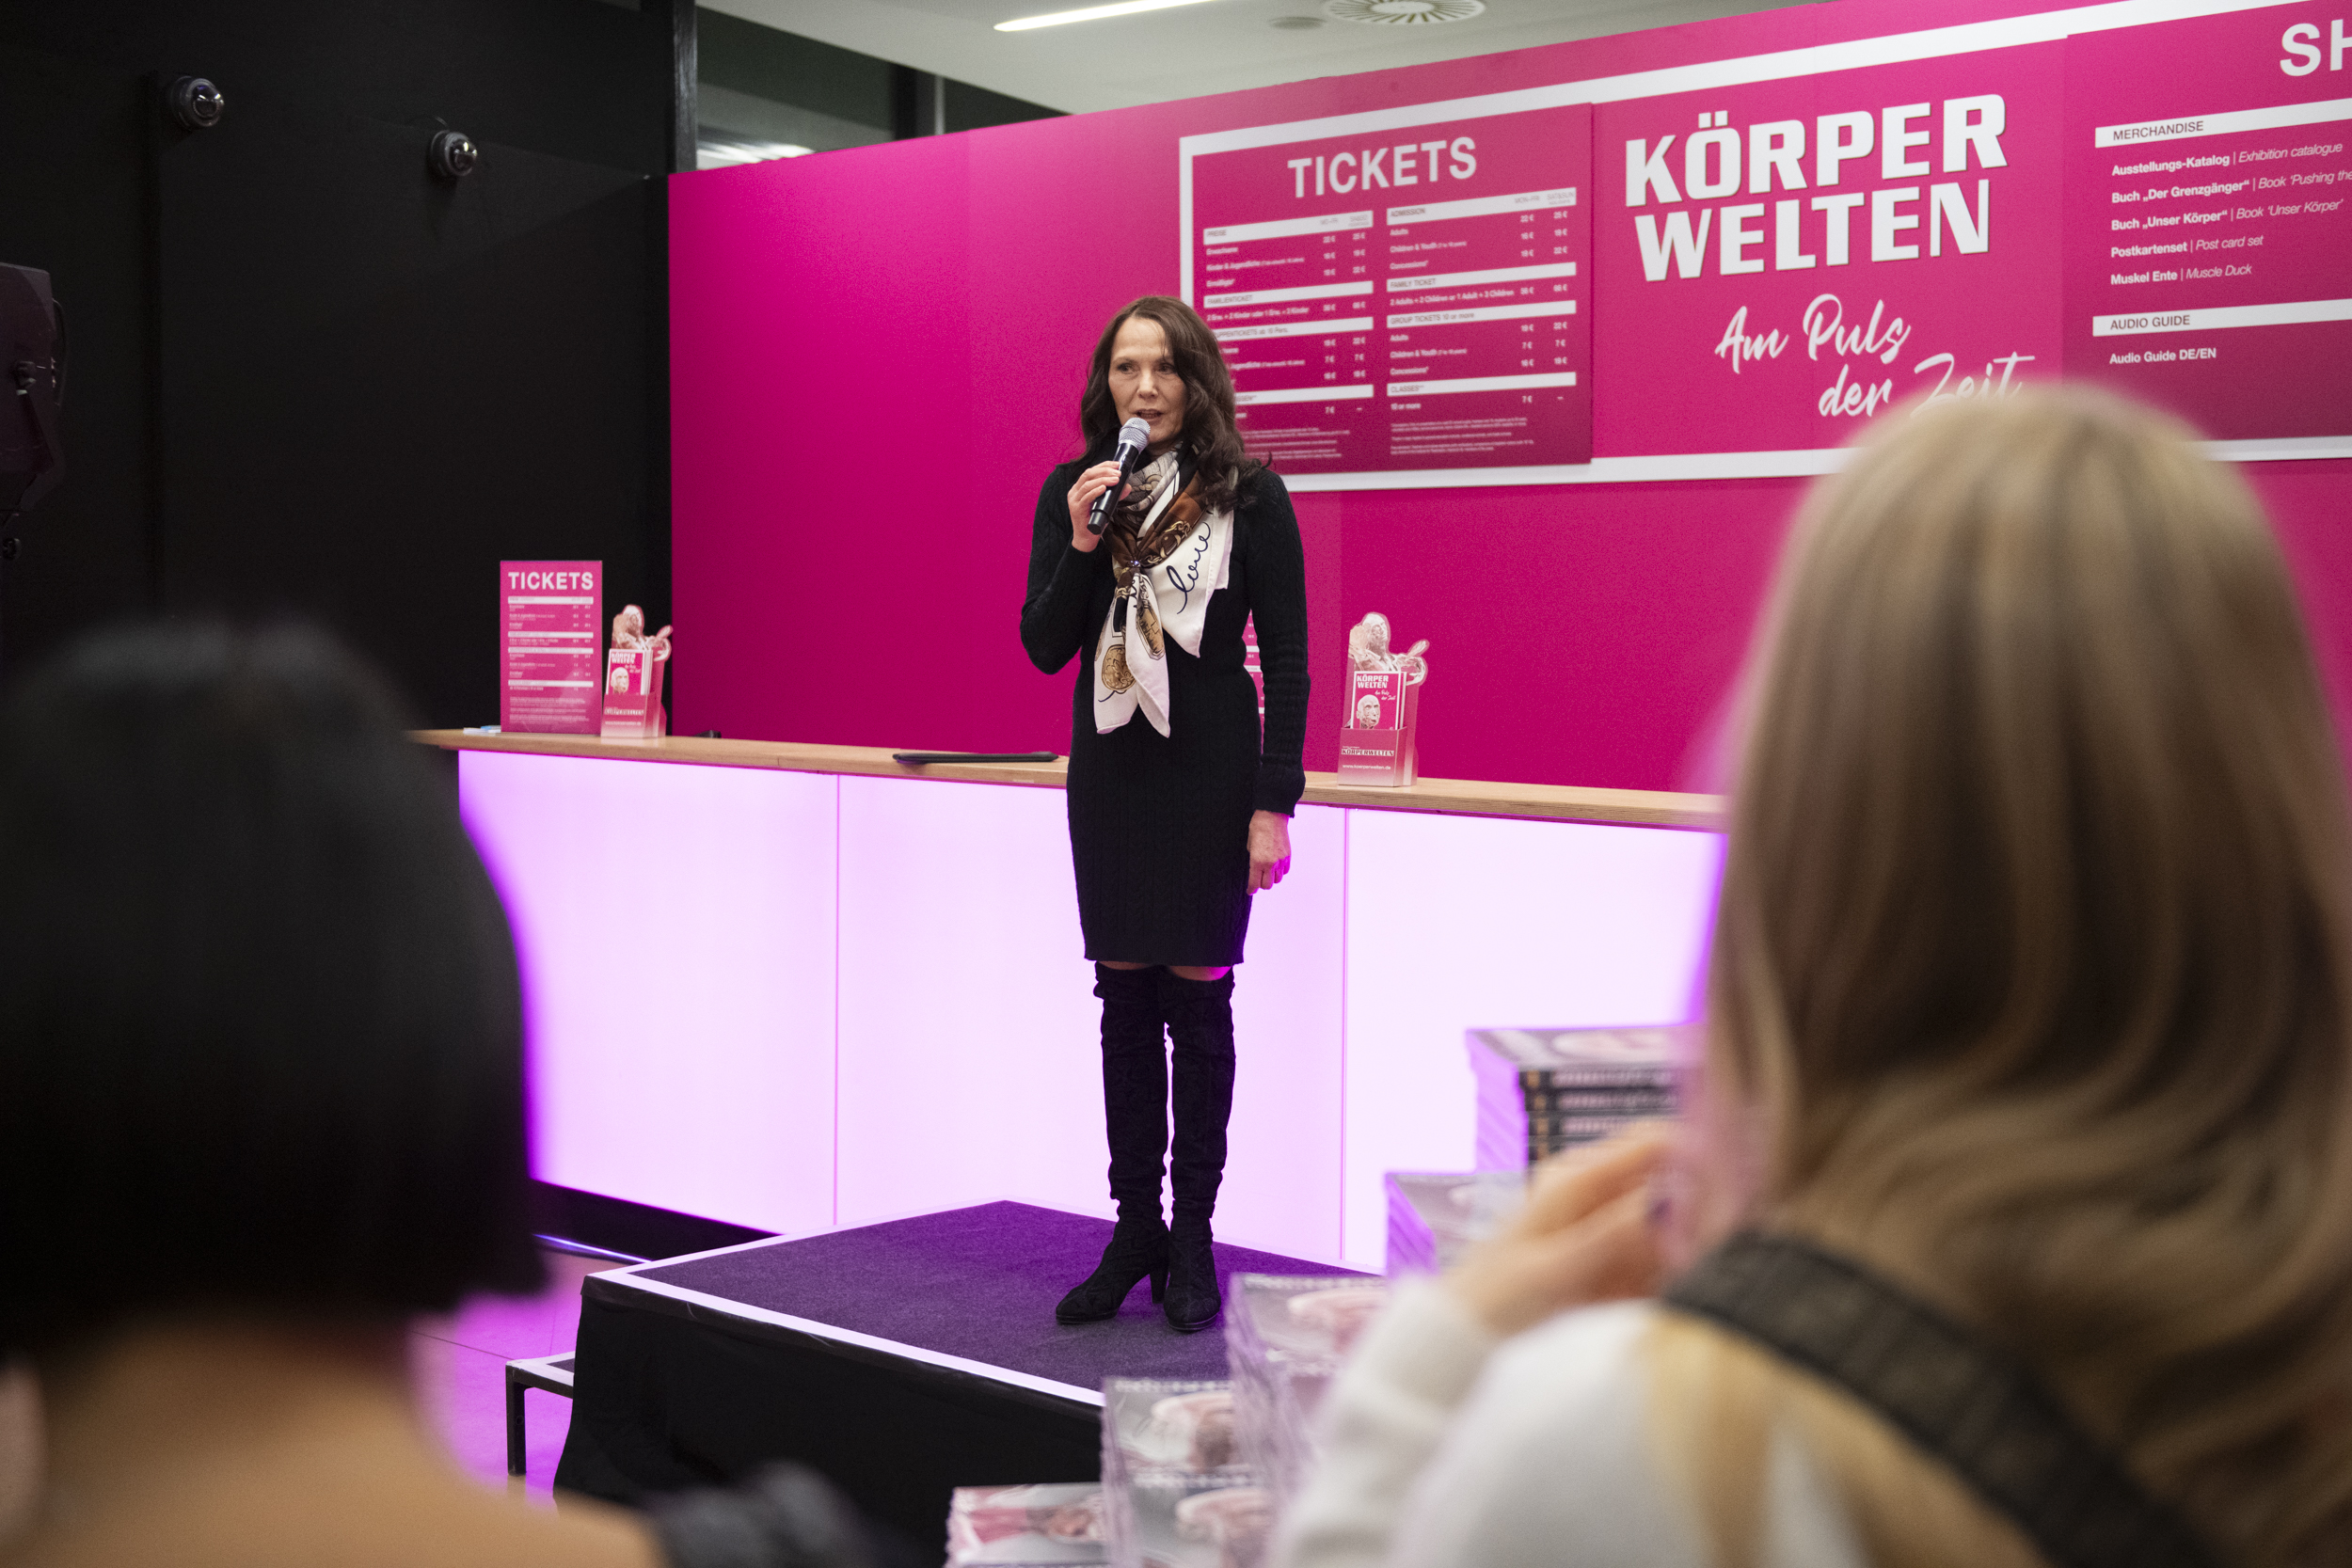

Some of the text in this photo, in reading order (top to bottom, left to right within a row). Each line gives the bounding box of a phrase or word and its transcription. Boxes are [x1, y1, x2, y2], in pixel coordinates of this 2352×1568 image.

[2280, 19, 2352, 77] SH
[2113, 120, 2204, 141] MERCHANDISE
[1626, 93, 2008, 207] KÖRPER
[2111, 143, 2343, 177] Ausstellungs-Katalog Exhibition catalogue
[1287, 136, 1477, 198] TICKETS
[2111, 191, 2140, 203] Buch
[2171, 180, 2249, 199] Grenzgänger“
[2258, 176, 2286, 189] Book
[2337, 169, 2352, 182] the
[1391, 208, 1426, 217] ADMISSION
[2111, 219, 2139, 231] Buch
[2236, 207, 2264, 219] Book
[1634, 179, 1990, 281] WELTEN
[2111, 235, 2265, 258] Postkartenset Post card set
[2111, 263, 2252, 286] Muskel Ente Muscle Duck
[1391, 315, 1412, 325] GROUP
[1414, 314, 1440, 323] TICKETS
[2110, 315, 2191, 330] AUDIO GUIDE
[1714, 293, 1912, 374] Am Puls
[2109, 347, 2217, 365] Audio Guide DE/EN
[1818, 351, 2036, 419] der Zeit
[508, 572, 594, 591] TICKETS
[1357, 673, 1389, 682] KÖRPER
